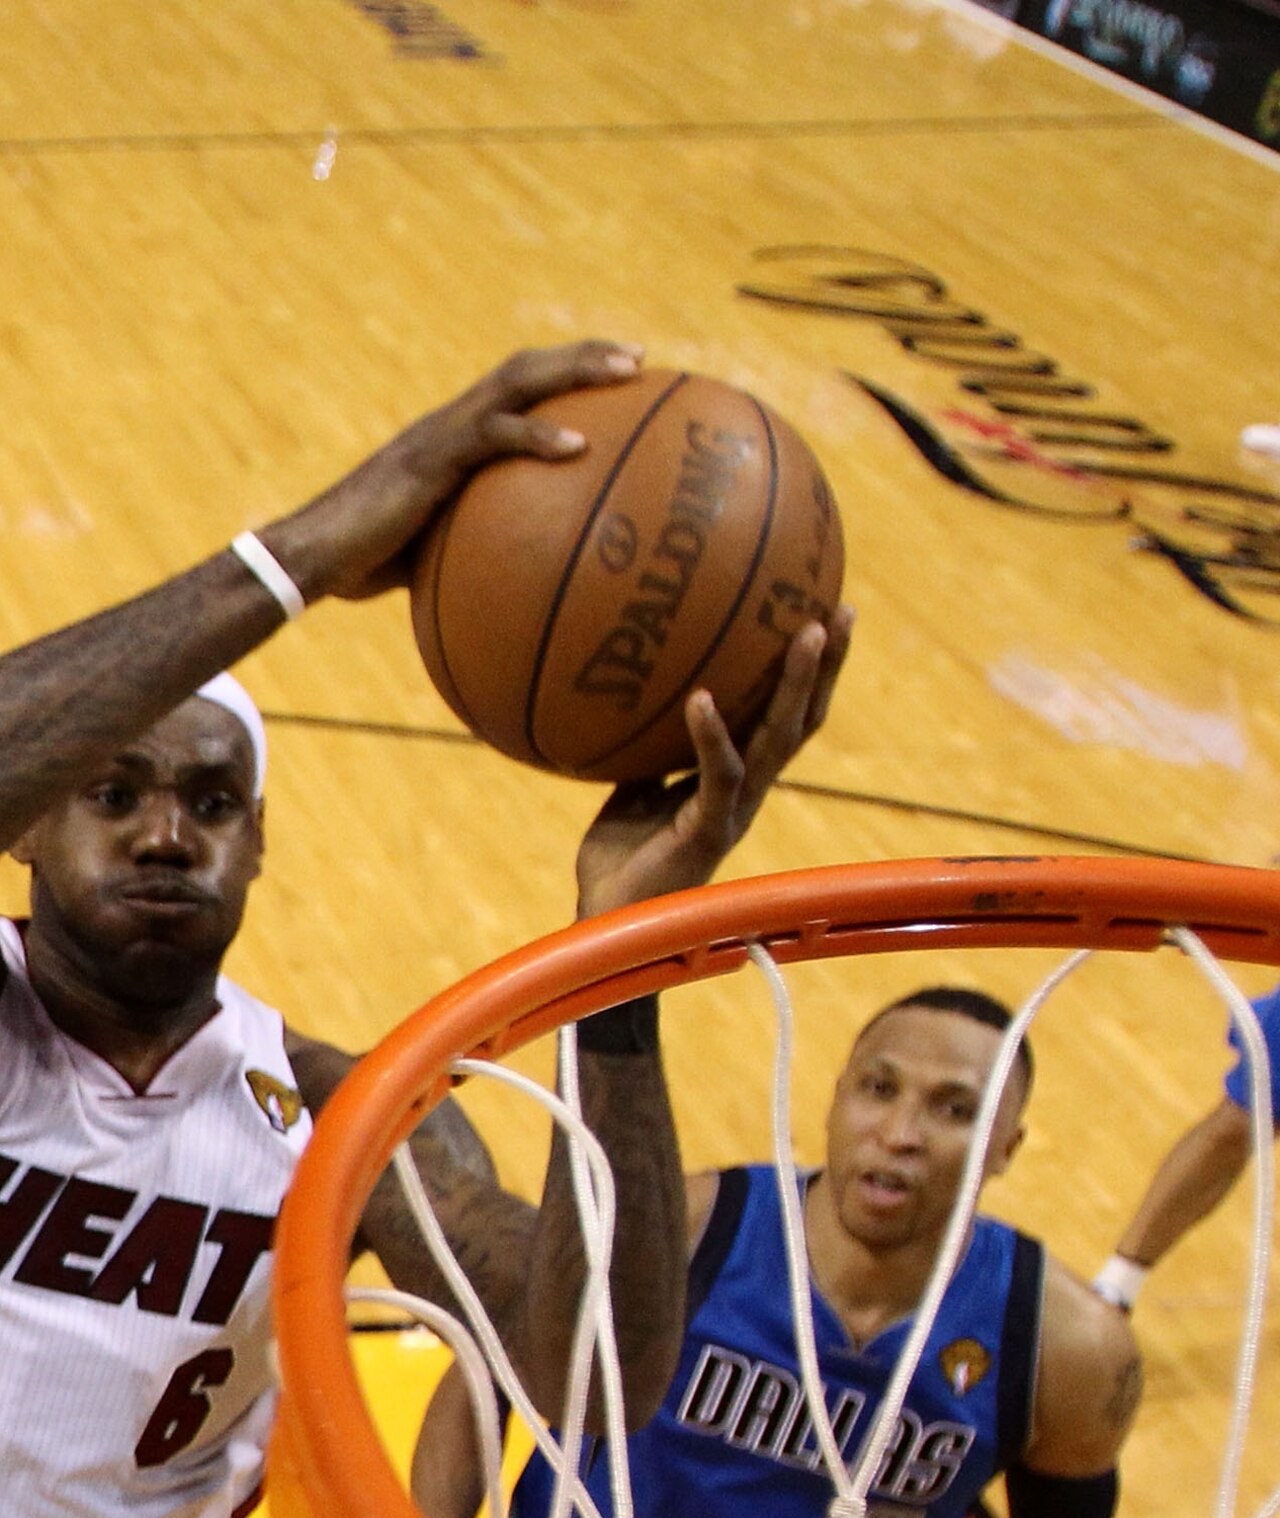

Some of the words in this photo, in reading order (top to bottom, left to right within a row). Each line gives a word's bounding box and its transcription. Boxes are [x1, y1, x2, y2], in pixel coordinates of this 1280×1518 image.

[572, 420, 753, 708] SPALDING
[134, 1347, 236, 1471] 6
[676, 1344, 977, 1506] DALLAS
